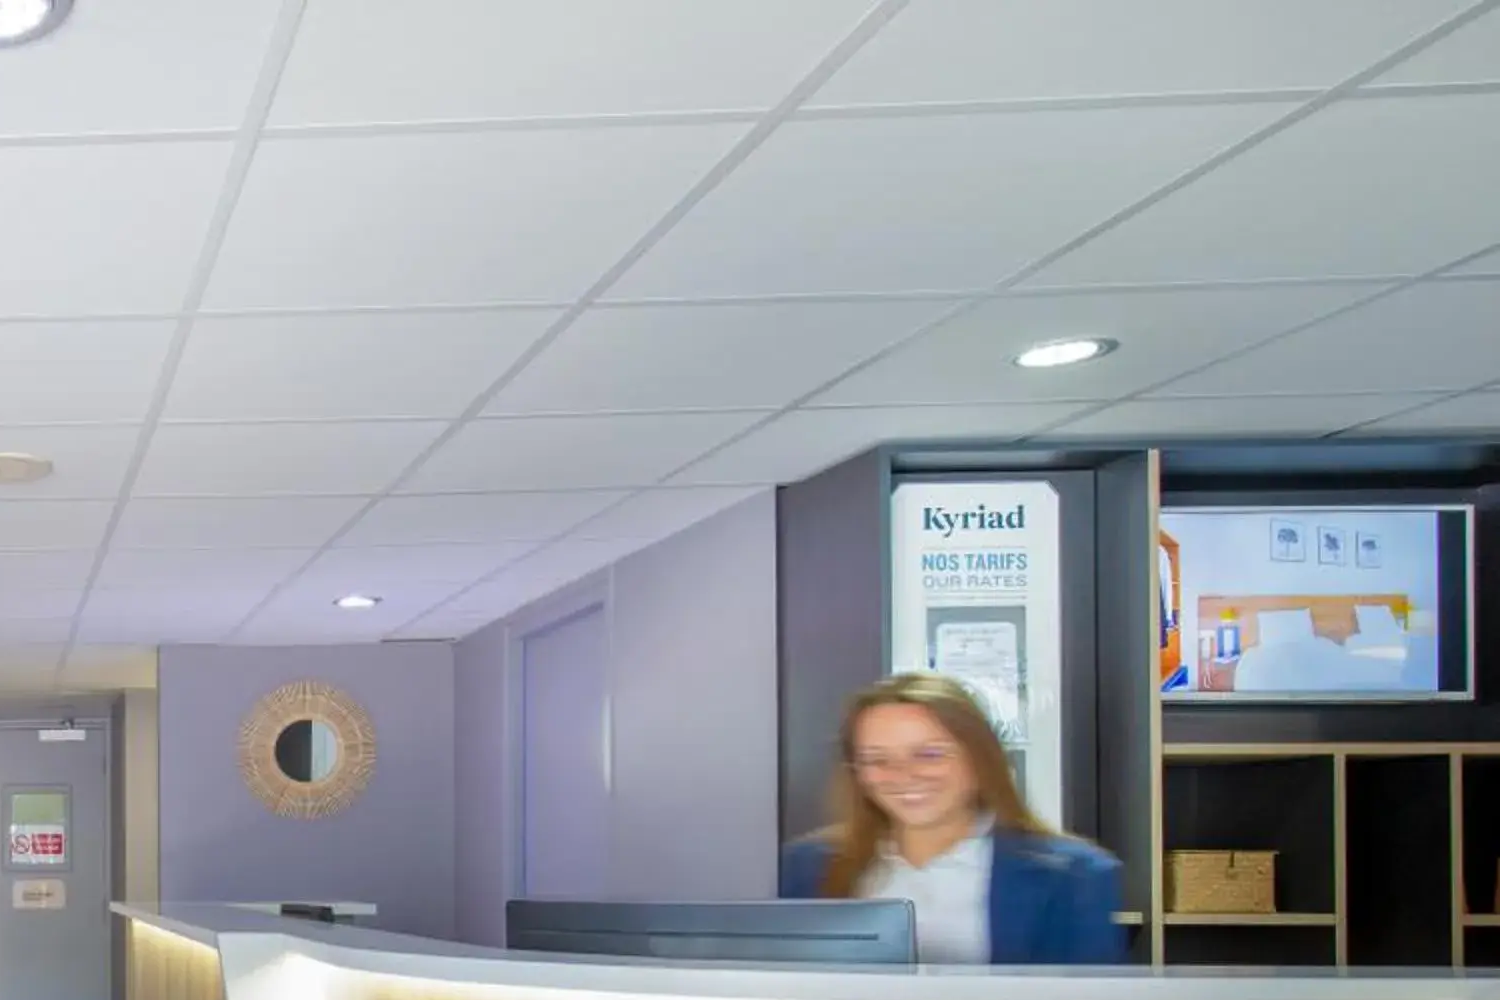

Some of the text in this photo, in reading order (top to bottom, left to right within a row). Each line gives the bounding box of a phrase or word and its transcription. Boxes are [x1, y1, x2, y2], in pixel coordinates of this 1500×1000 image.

[922, 504, 1025, 538] Kyriad
[922, 552, 1028, 571] NOS TARIFS
[922, 574, 1028, 588] OUR RATES
